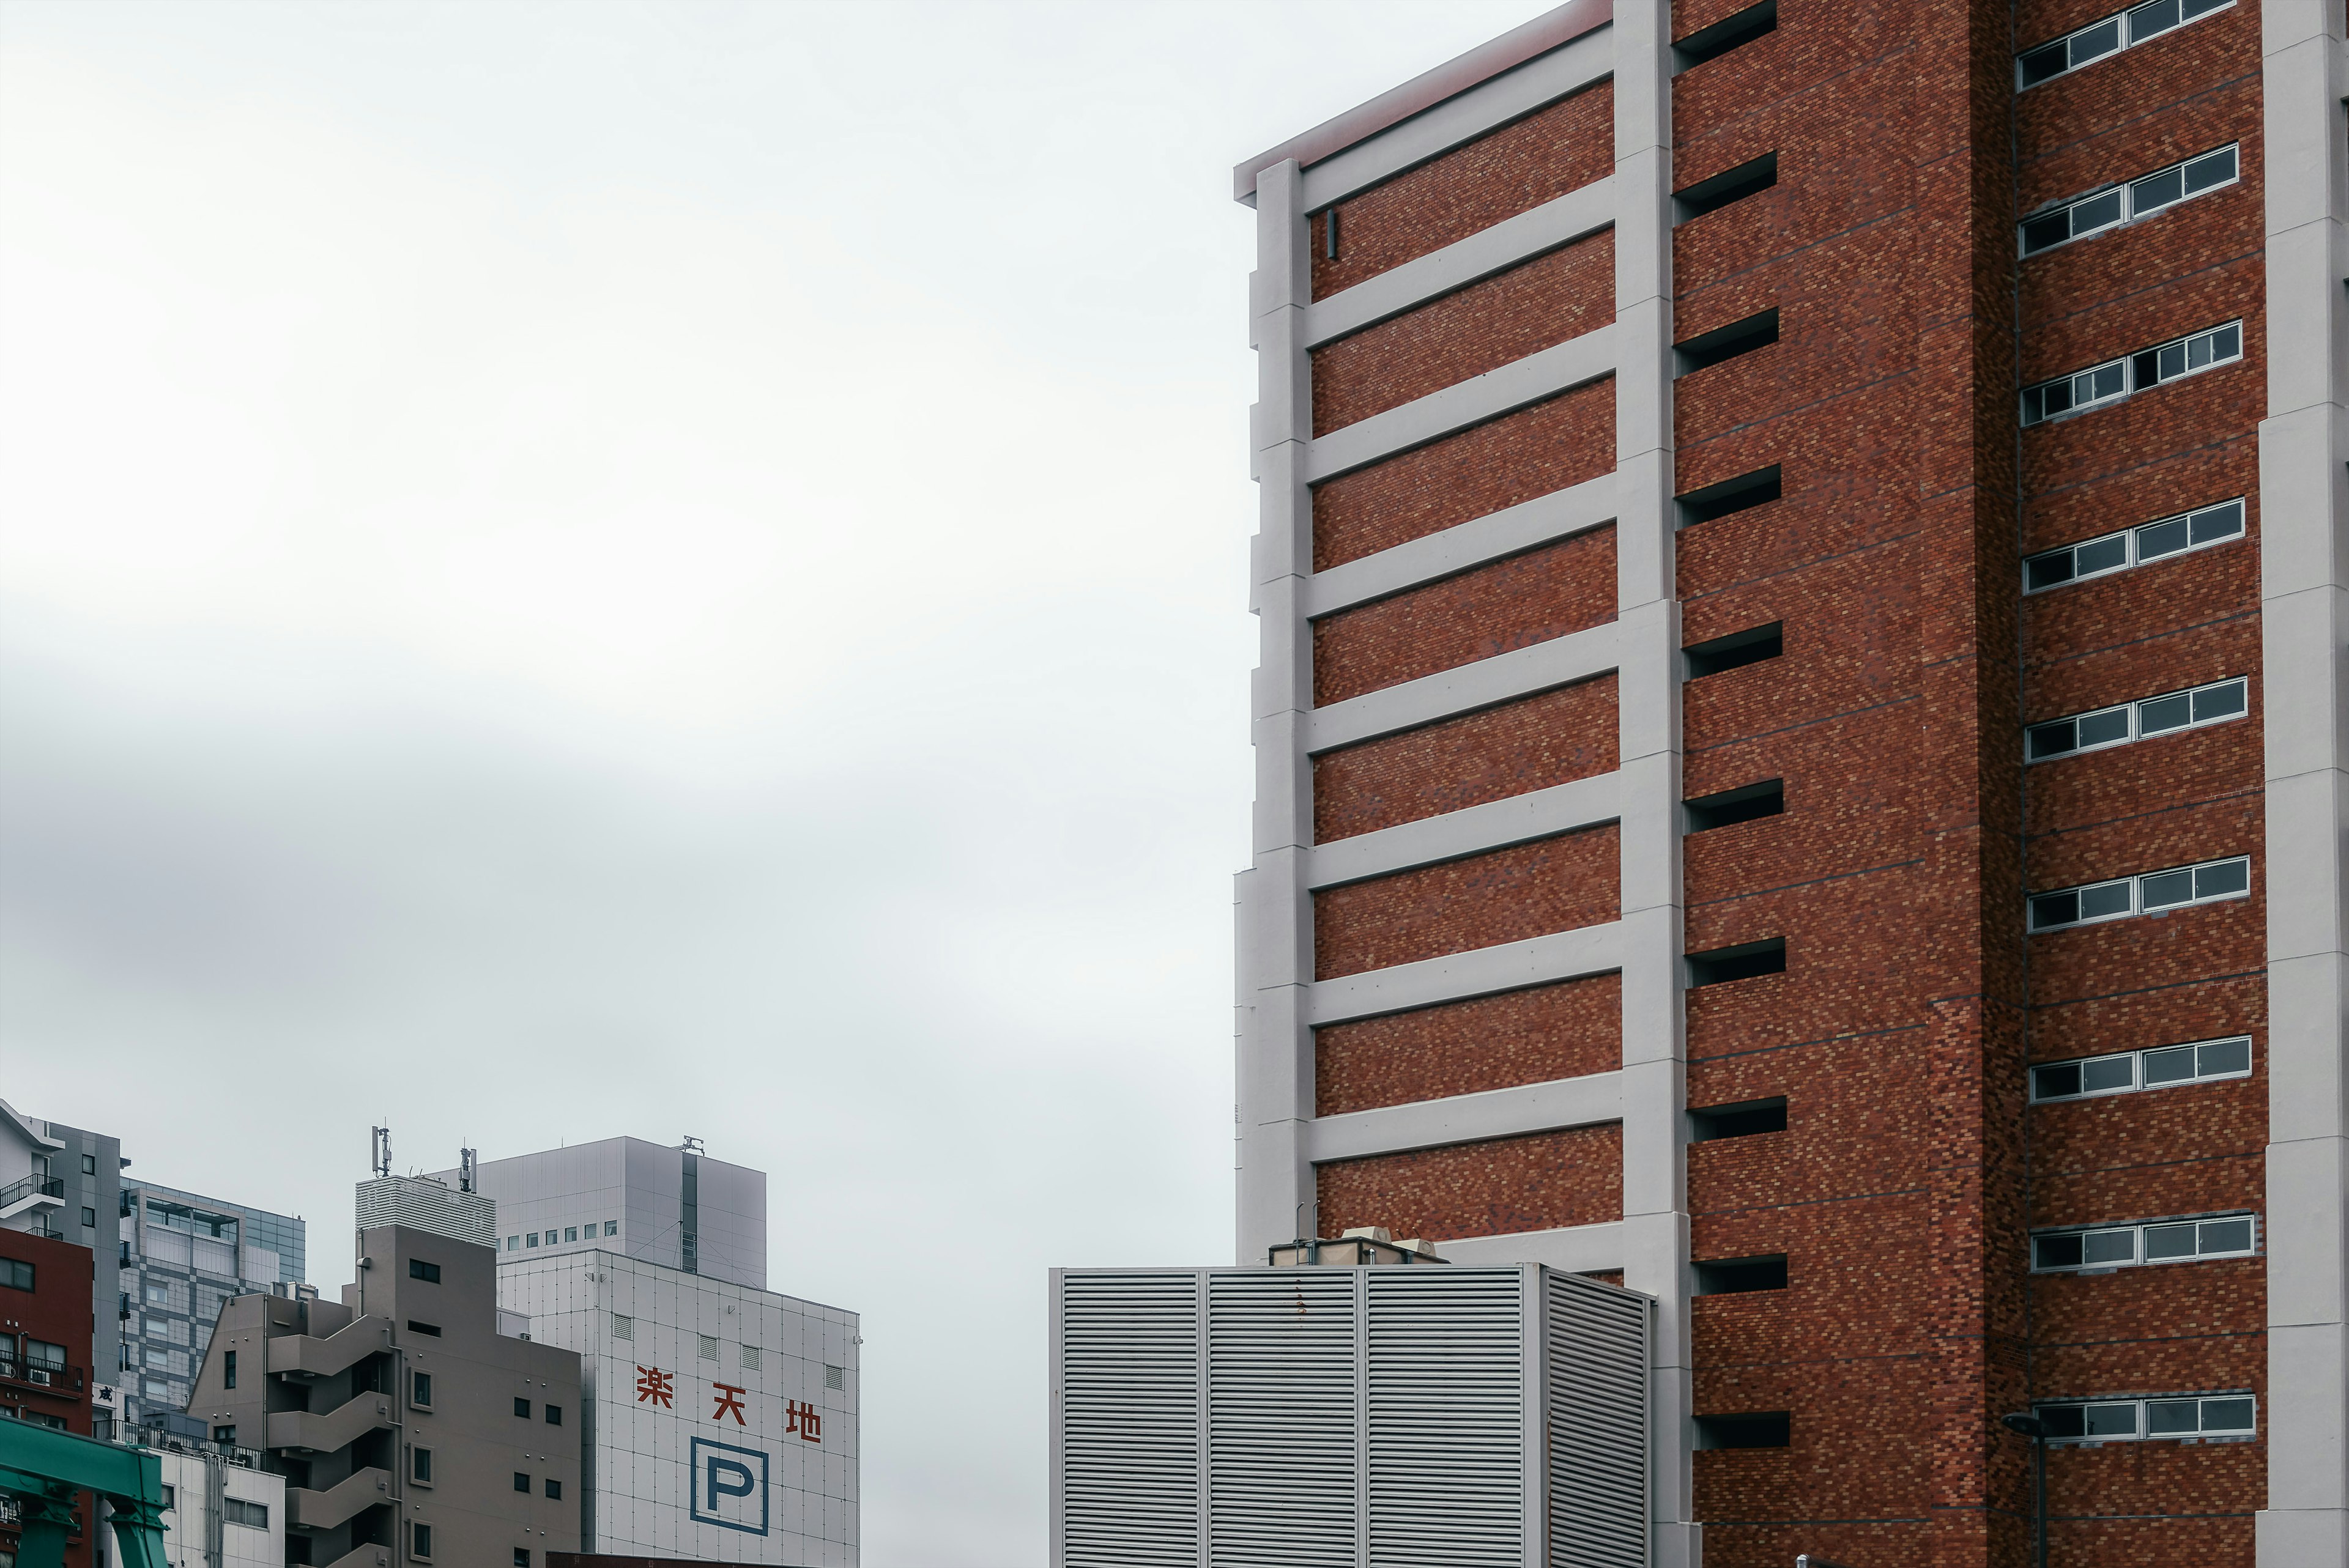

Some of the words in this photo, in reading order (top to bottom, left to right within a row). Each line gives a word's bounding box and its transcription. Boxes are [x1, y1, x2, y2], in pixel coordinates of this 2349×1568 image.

[92, 1386, 113, 1402] 成
[637, 1364, 821, 1443] 楽天地
[707, 1455, 754, 1511] P
